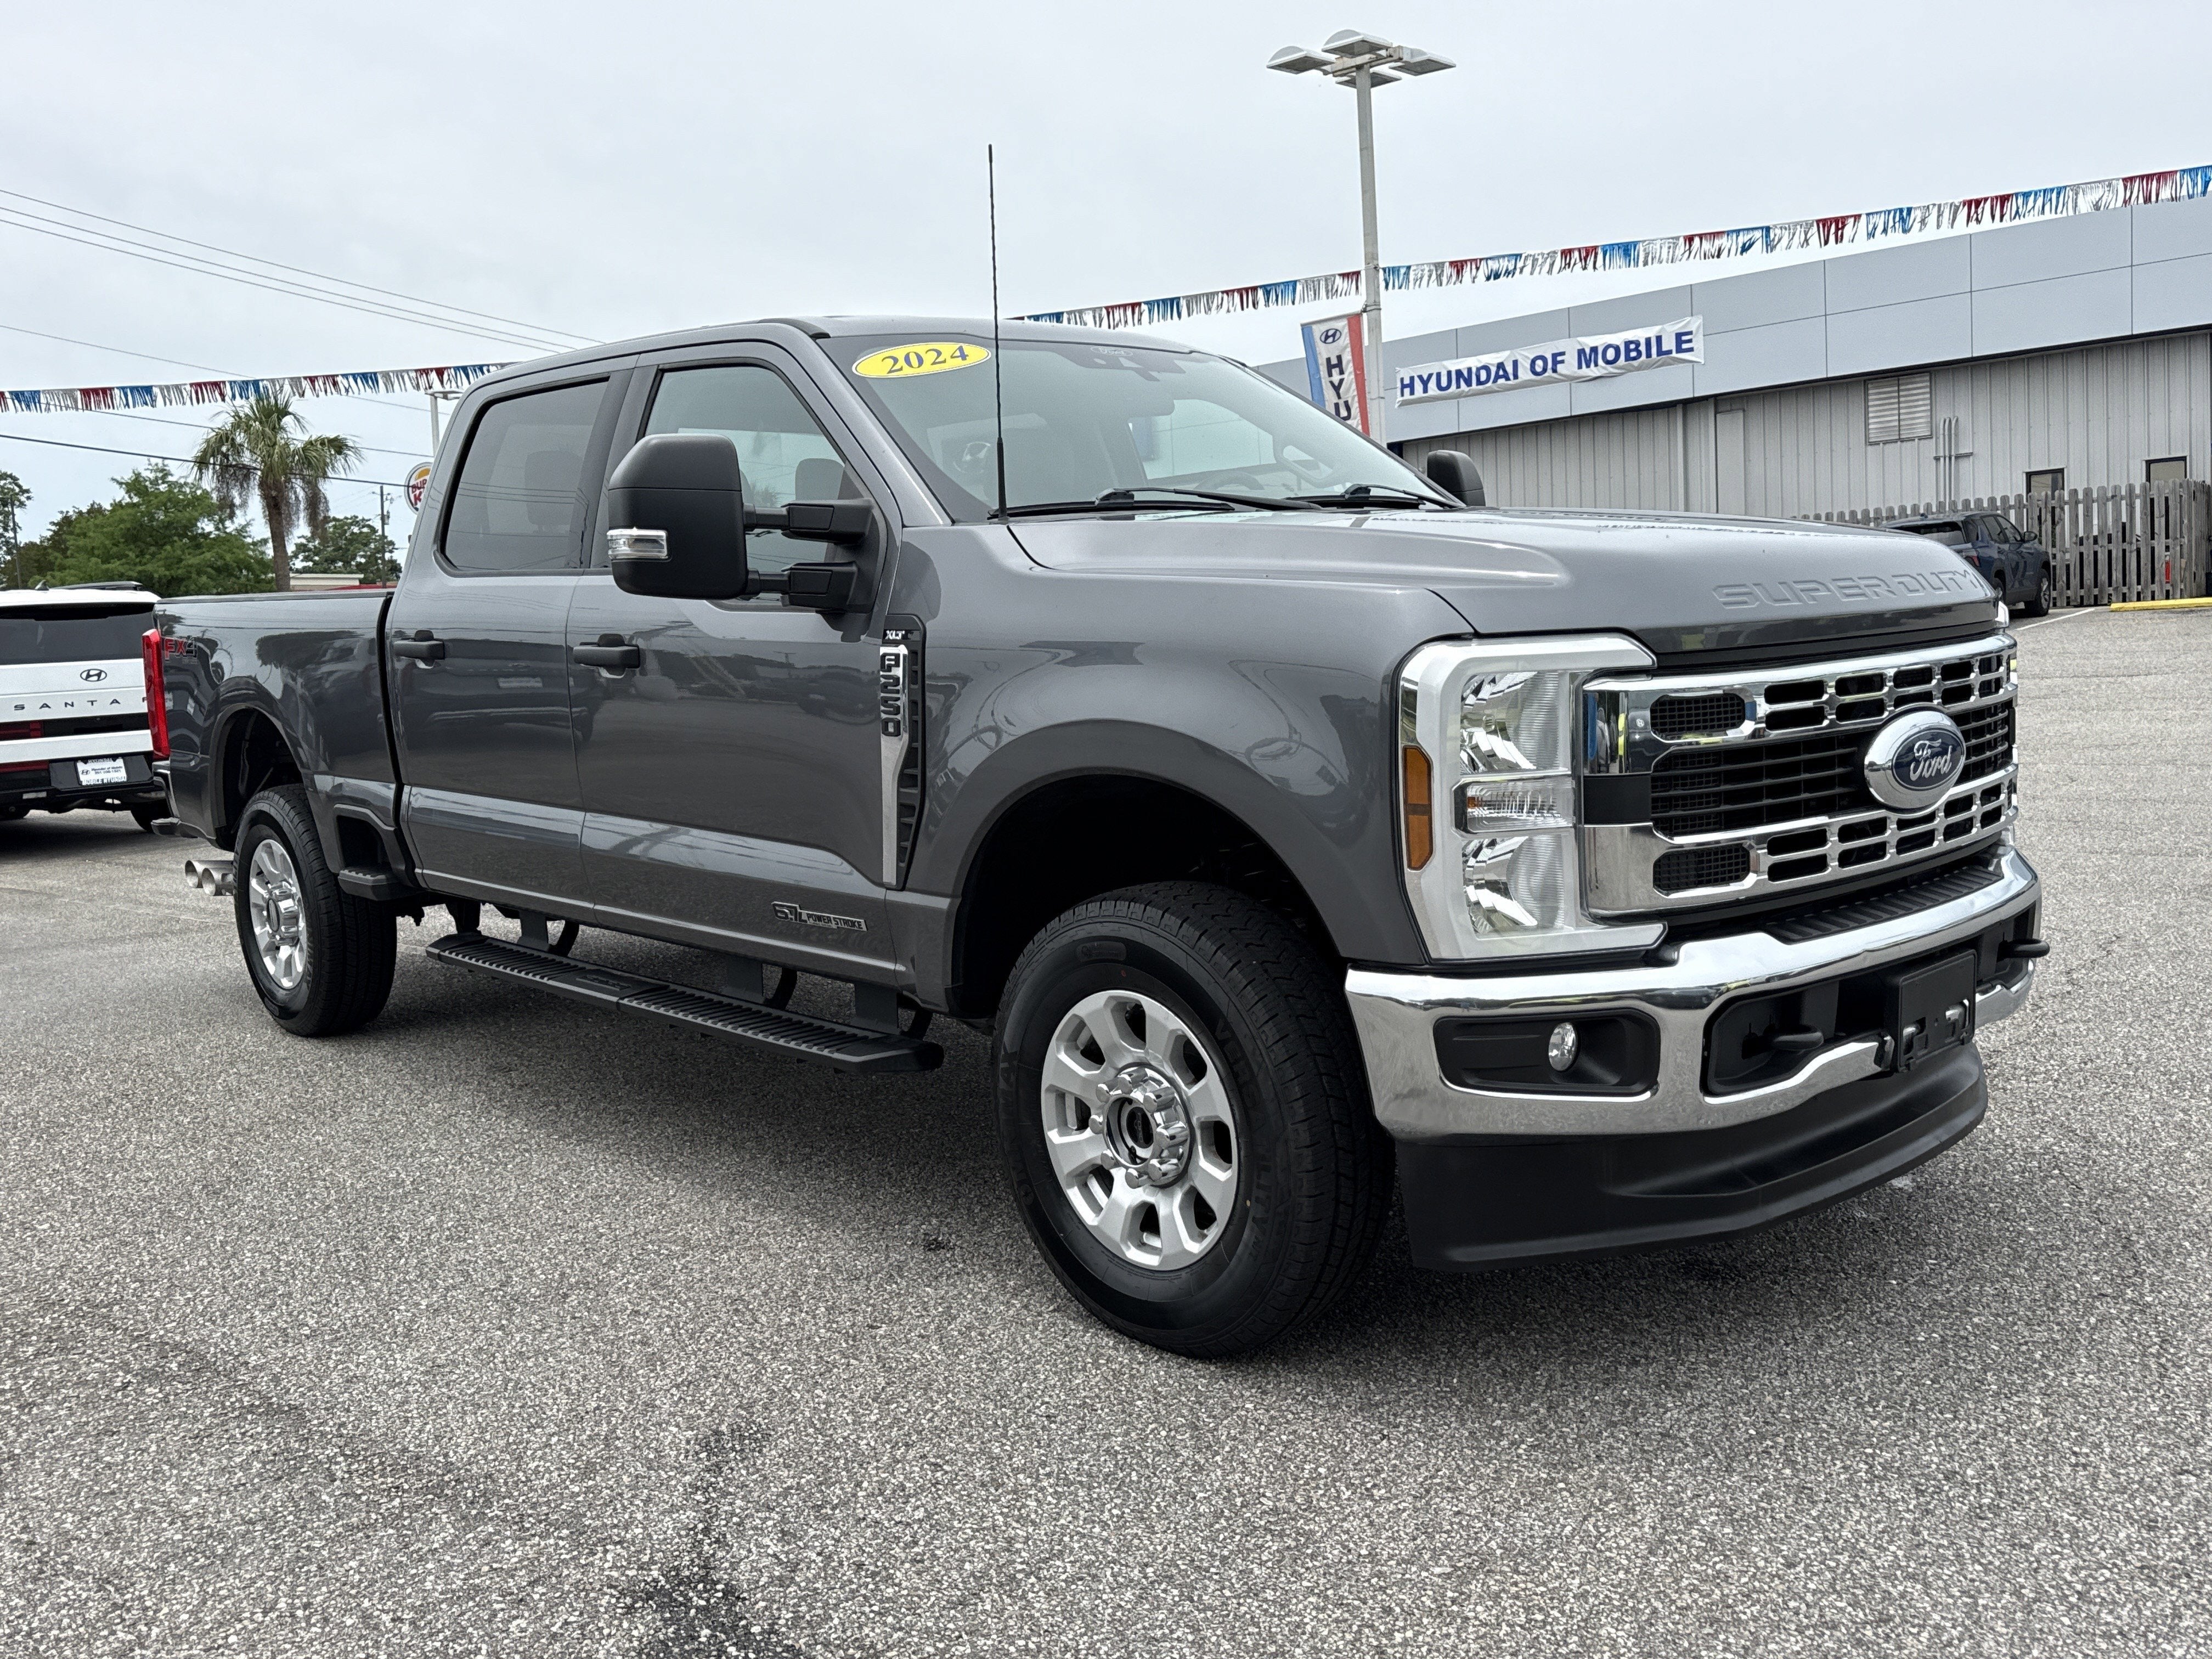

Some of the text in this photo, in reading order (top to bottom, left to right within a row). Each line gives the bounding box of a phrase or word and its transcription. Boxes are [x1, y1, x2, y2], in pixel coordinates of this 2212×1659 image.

[881, 345, 969, 375] 2024
[1400, 330, 1695, 397] HYUNDAI OF MOBILE
[1711, 569, 1979, 610] SUPER DUTY
[884, 630, 905, 640] XLT
[164, 637, 198, 663] FX4
[13, 698, 121, 711] SANTA
[1909, 738, 1953, 781] Ford
[772, 902, 808, 923] 6.7L
[806, 912, 833, 925] POWER
[832, 917, 864, 930] STROKE
